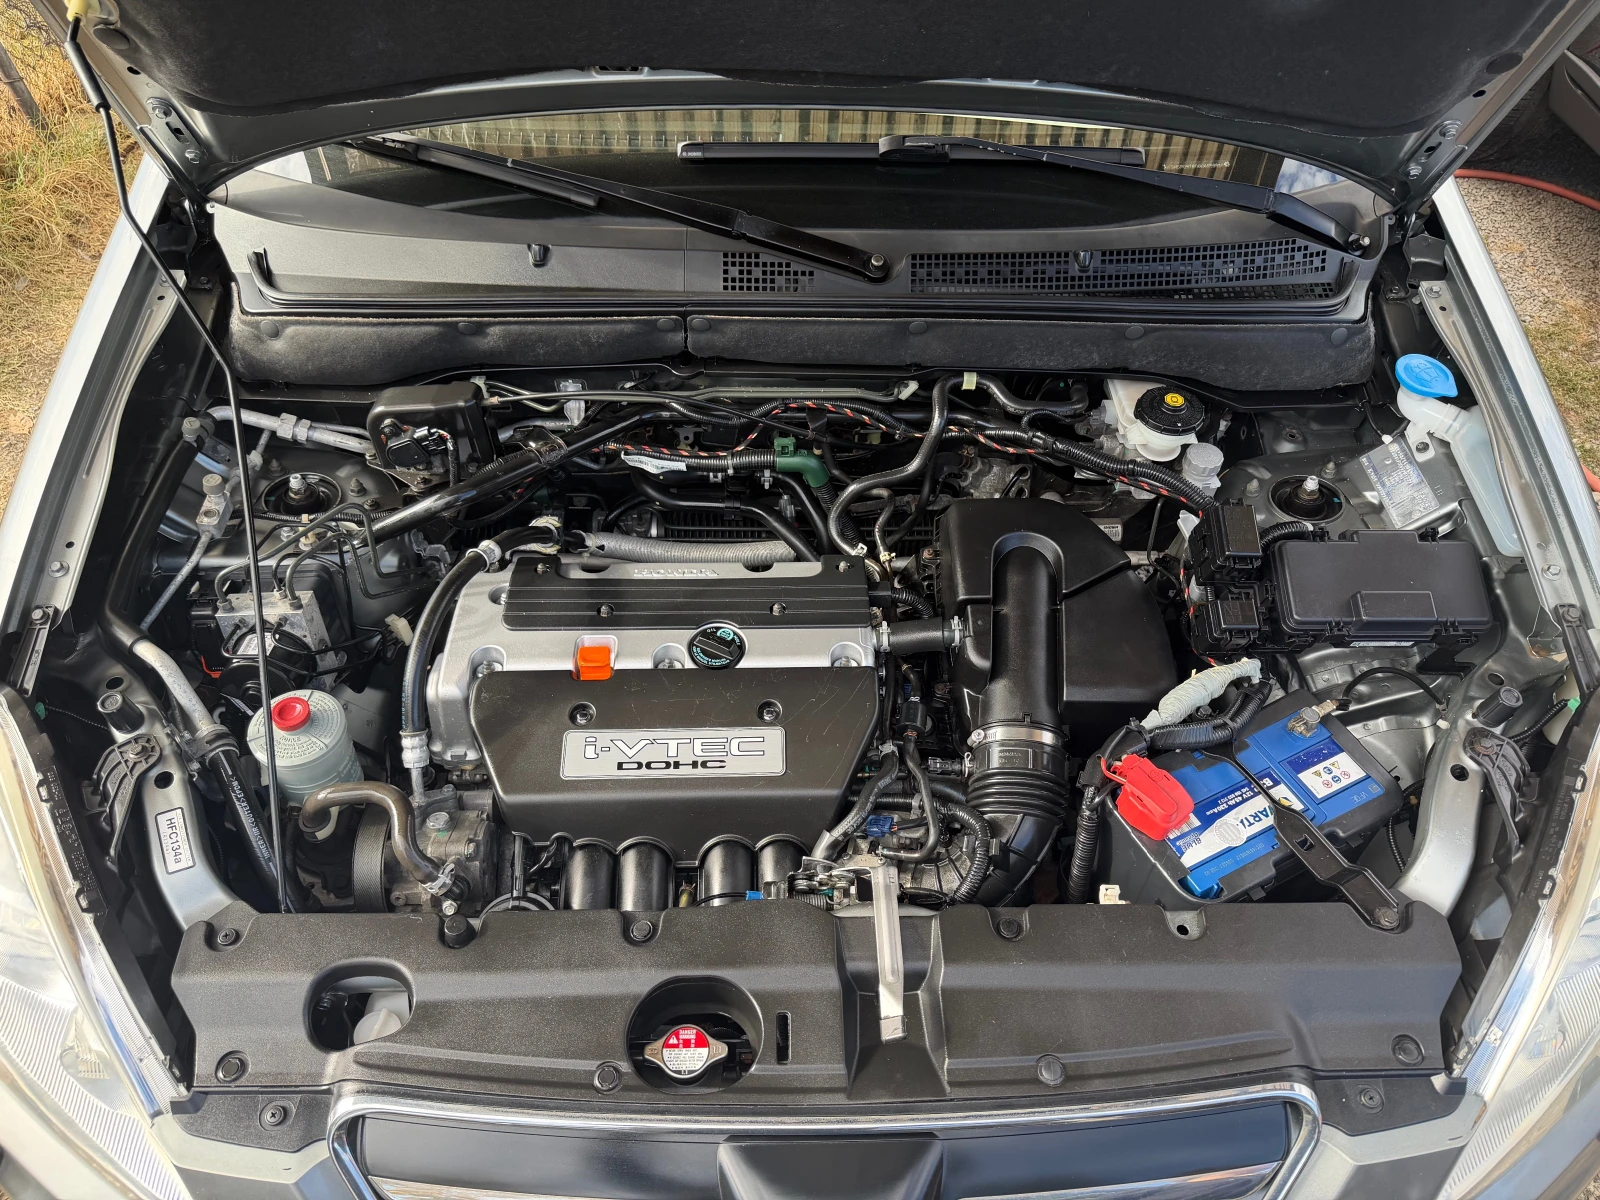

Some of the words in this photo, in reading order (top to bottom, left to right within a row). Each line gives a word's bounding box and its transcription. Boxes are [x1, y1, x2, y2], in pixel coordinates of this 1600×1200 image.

[583, 736, 765, 759] i-VTEC
[617, 759, 727, 771] DOHC
[165, 817, 183, 864] HFC134a
